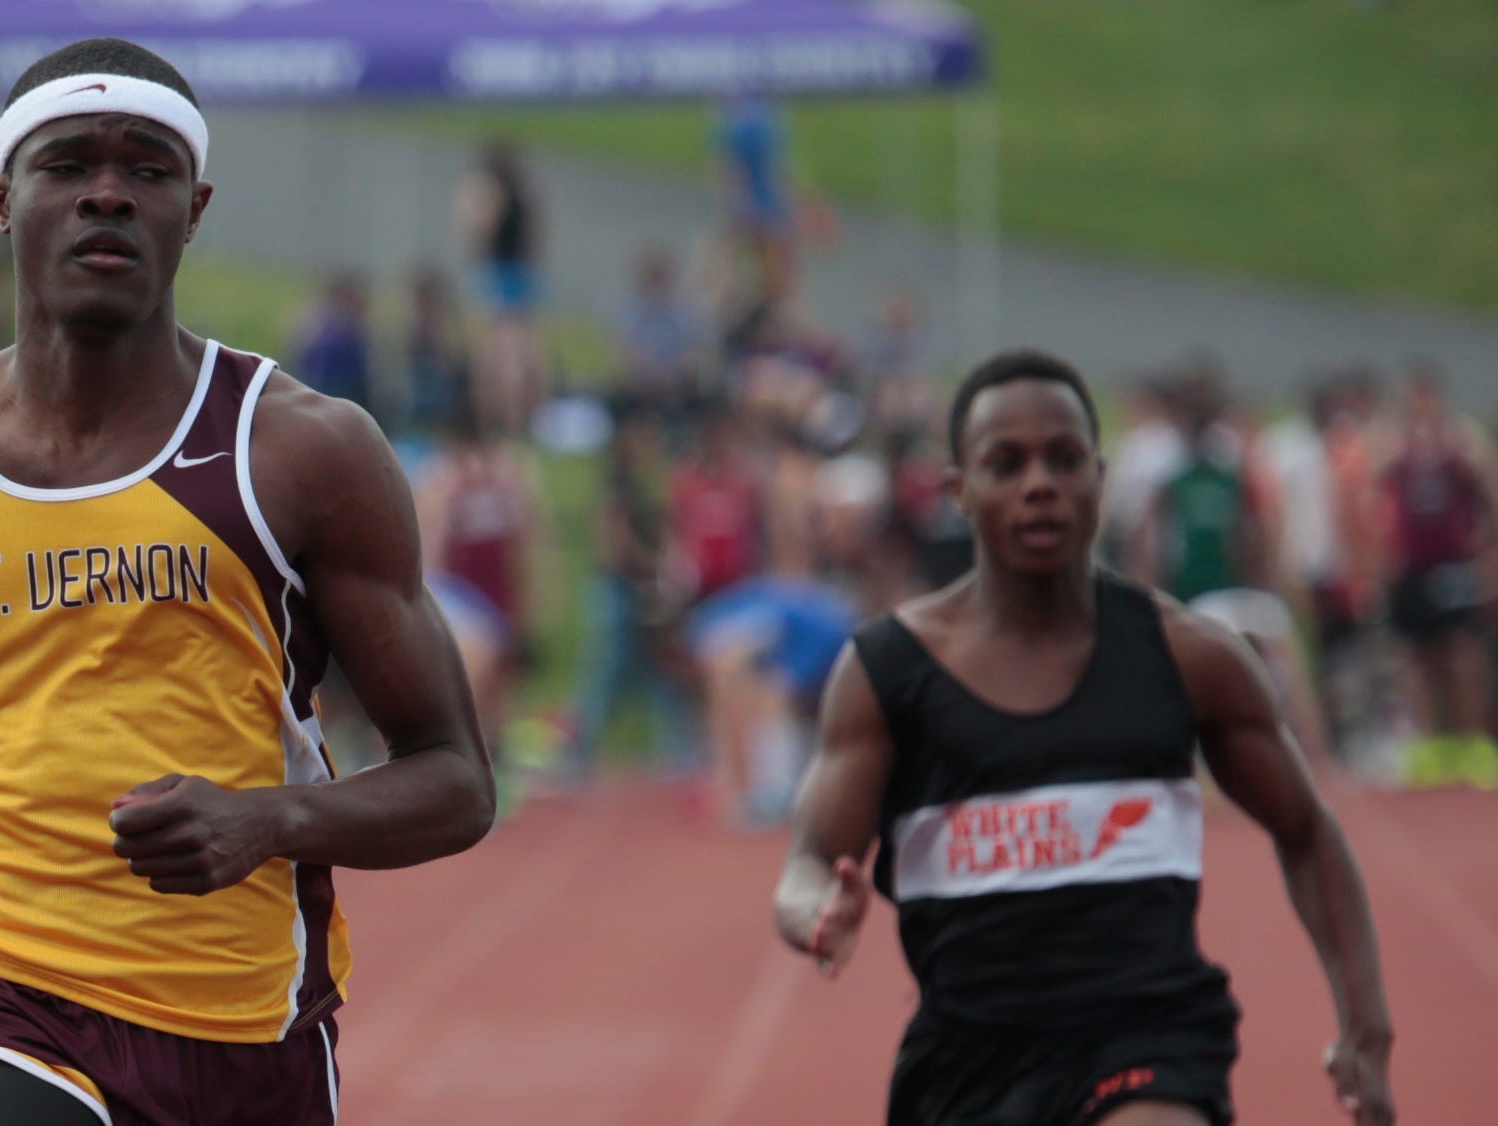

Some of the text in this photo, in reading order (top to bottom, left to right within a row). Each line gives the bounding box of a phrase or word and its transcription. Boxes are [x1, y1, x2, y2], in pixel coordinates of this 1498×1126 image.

[26, 543, 210, 612] VERNON
[947, 799, 1072, 837] WHITE
[948, 832, 1084, 875] PLAINS
